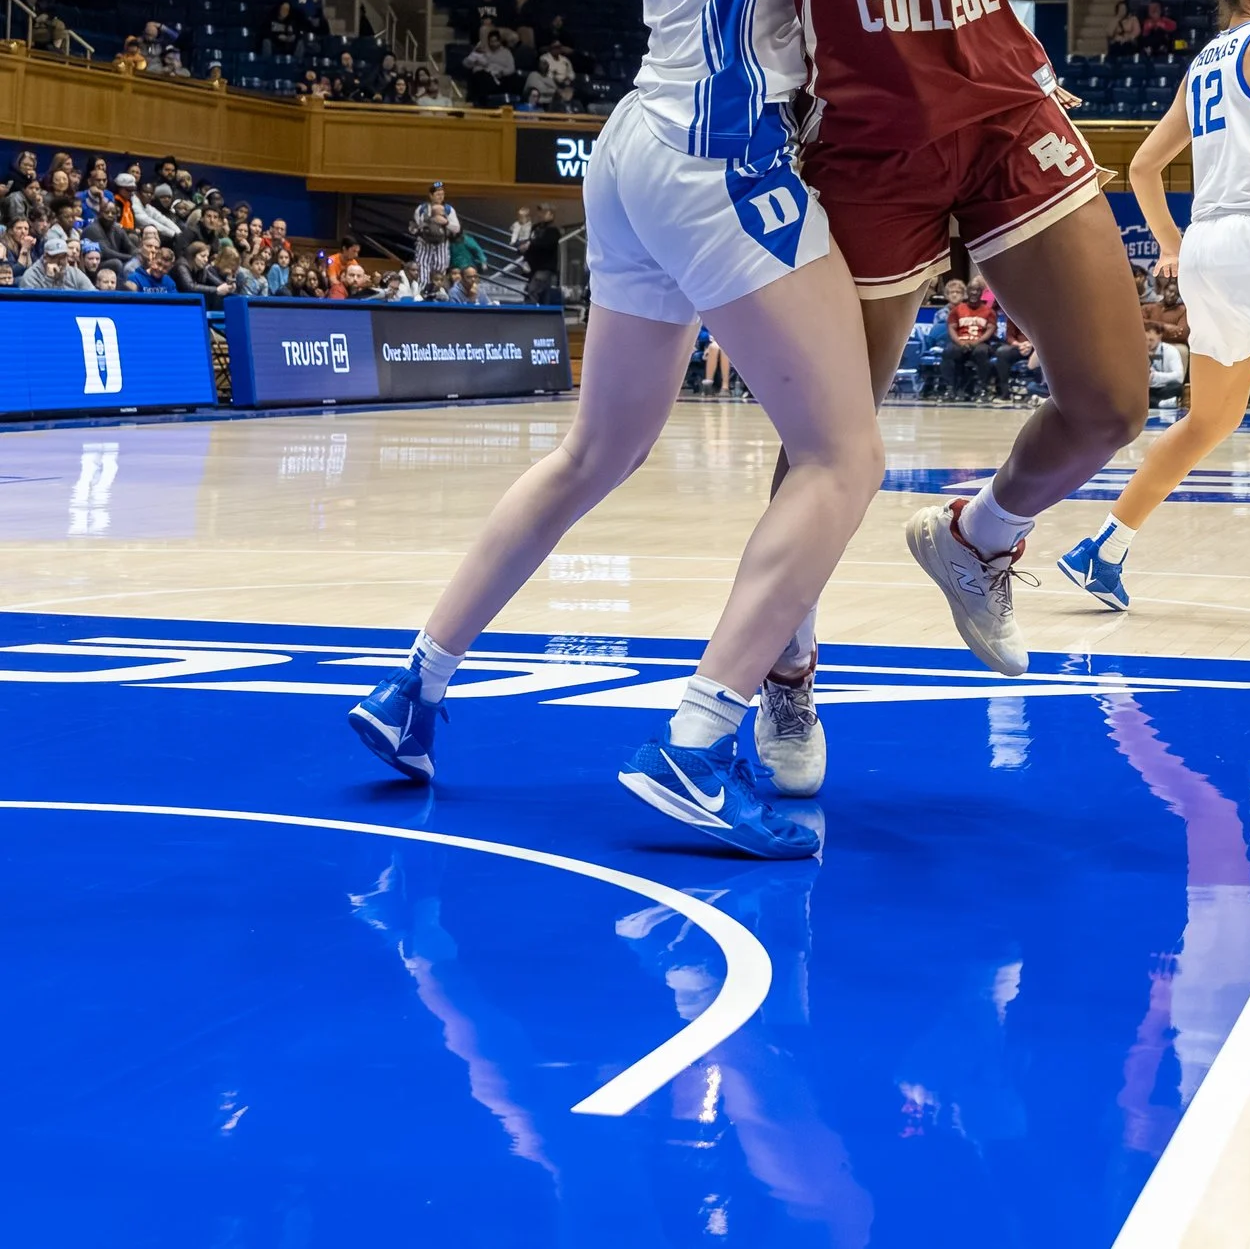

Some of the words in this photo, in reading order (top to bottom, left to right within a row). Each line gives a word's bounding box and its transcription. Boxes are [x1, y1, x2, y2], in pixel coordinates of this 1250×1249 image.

[1191, 68, 1227, 138] 12
[556, 138, 597, 161] DU
[1126, 241, 1158, 256] STER
[281, 341, 329, 366] TRUIST
[383, 343, 402, 362] Over
[401, 343, 411, 361] 30
[412, 343, 431, 361] Hotel
[431, 343, 456, 361] Brands
[456, 343, 466, 360] for
[466, 344, 485, 363] Every
[485, 343, 502, 360] Kind
[502, 343, 510, 359] of
[510, 343, 523, 360] Fan
